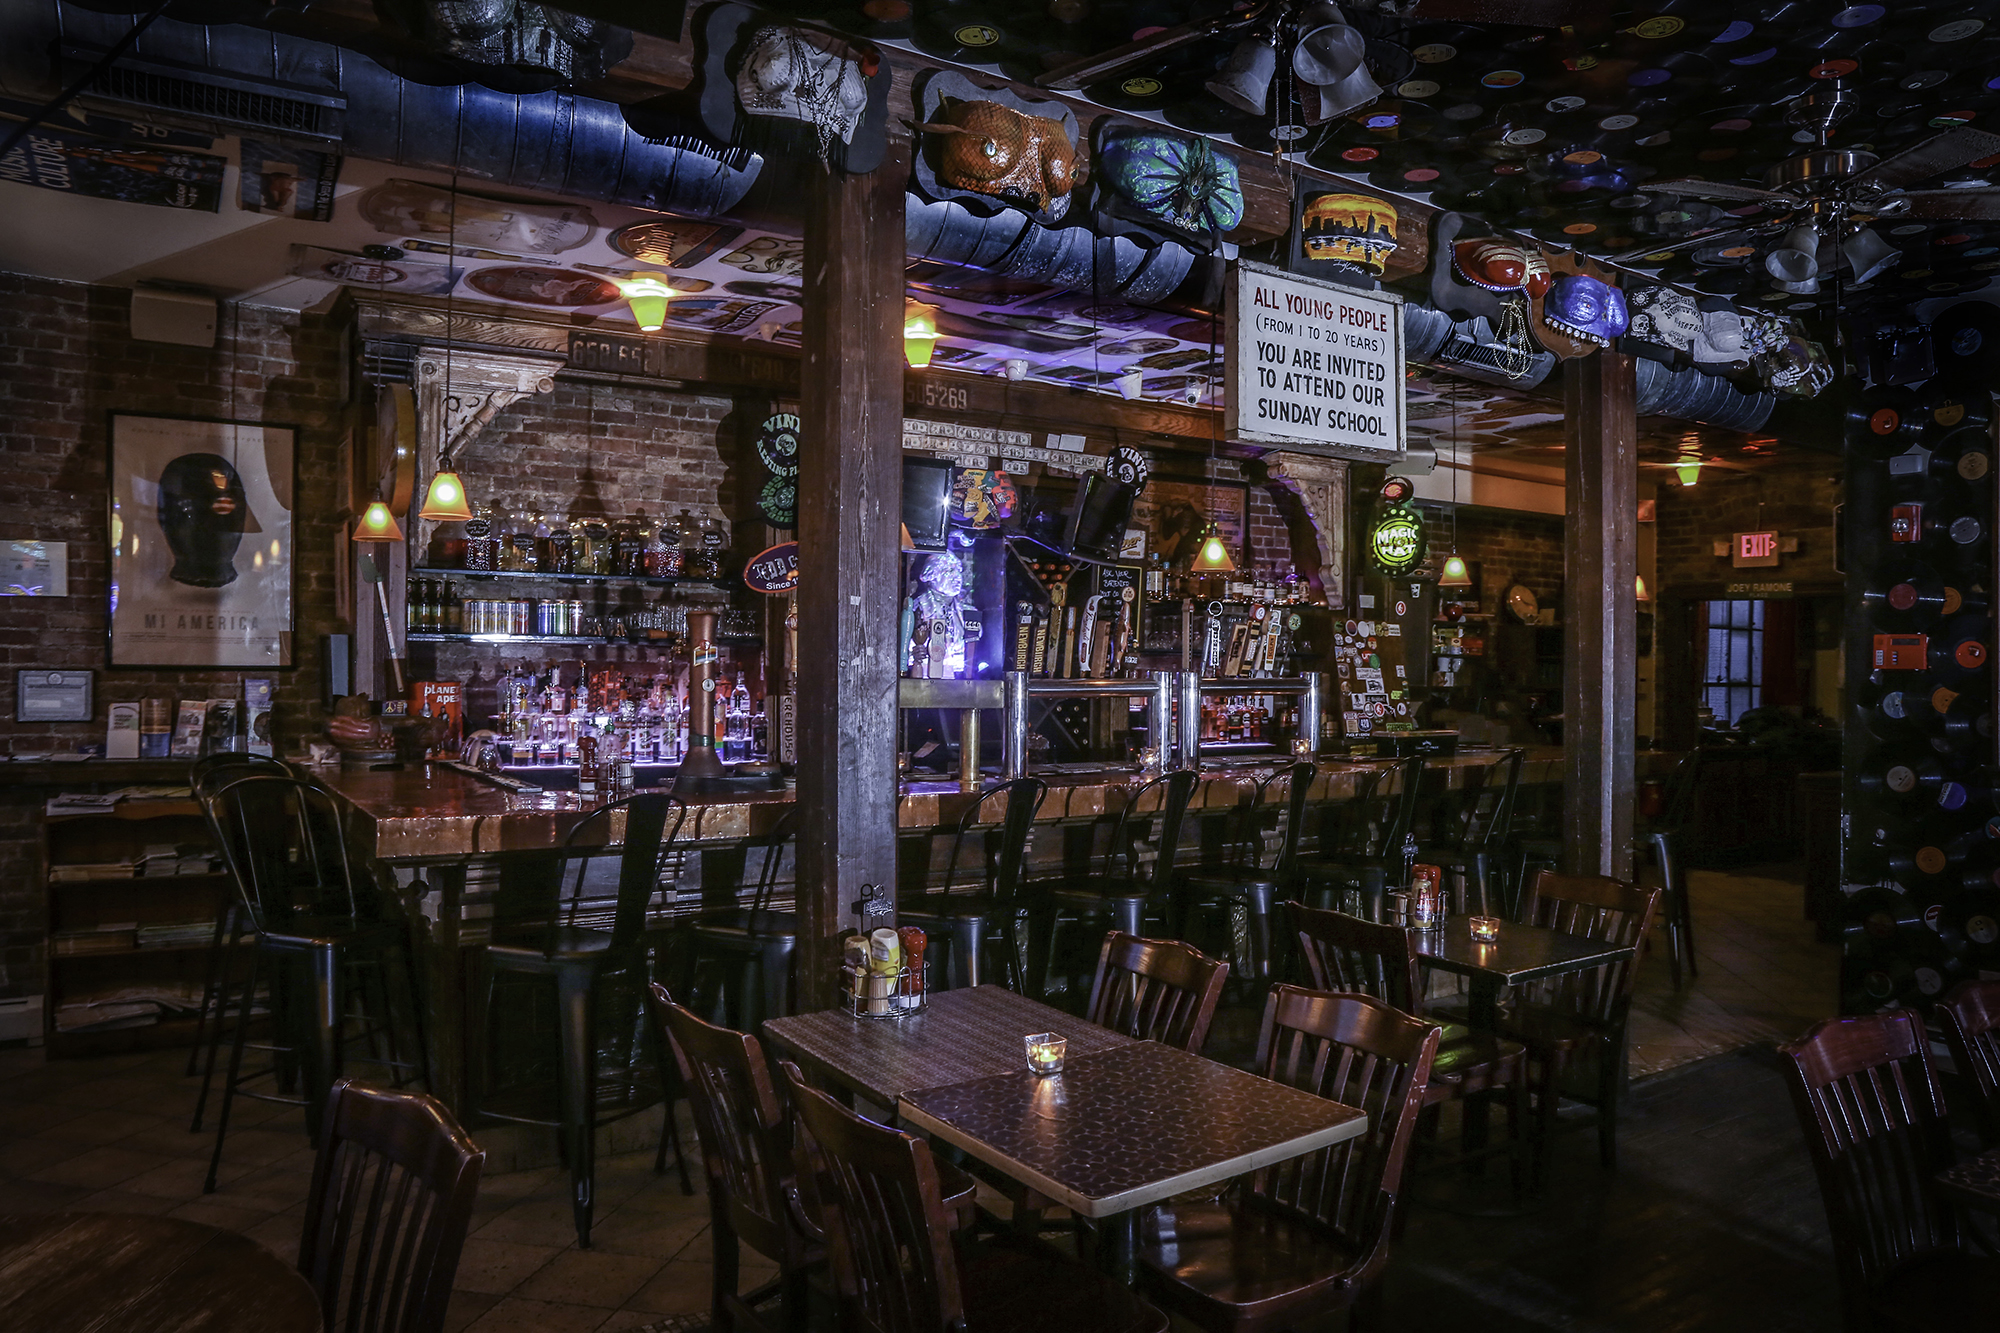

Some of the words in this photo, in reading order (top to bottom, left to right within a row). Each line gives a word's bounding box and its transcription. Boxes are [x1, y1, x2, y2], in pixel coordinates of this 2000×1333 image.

[28, 134, 73, 188] CULTURE
[1254, 287, 1279, 310] ALL
[1285, 293, 1334, 321] YOUNG
[1340, 305, 1387, 333] PEOPLE
[1256, 312, 1293, 336] (FROM
[1308, 326, 1320, 340] TO
[1325, 330, 1338, 344] 20
[1343, 333, 1385, 357] YEARS)
[1256, 341, 1286, 365] YOU
[1292, 348, 1321, 371] ARE
[1327, 354, 1385, 383] INVITED
[1257, 366, 1276, 389] TO
[1283, 372, 1346, 400] ATTEND
[1352, 383, 1385, 407] OUR
[1258, 398, 1321, 427] SUNDAY
[1328, 409, 1387, 437] SCHOOL
[757, 439, 787, 477] RESTING
[1120, 447, 1148, 483] VINYL
[1377, 528, 1417, 545] MAGIC
[1382, 544, 1416, 557] HAT
[1741, 533, 1772, 558] EXIT
[766, 582, 791, 590] Since
[1727, 583, 1750, 593] JOEY
[1753, 582, 1793, 592] RAMONE
[144, 613, 166, 630] MI
[176, 614, 260, 631] AMERICA
[1016, 626, 1029, 670] NEWBURGH
[1033, 628, 1047, 673] NEWBURGH
[436, 695, 460, 705] APES
